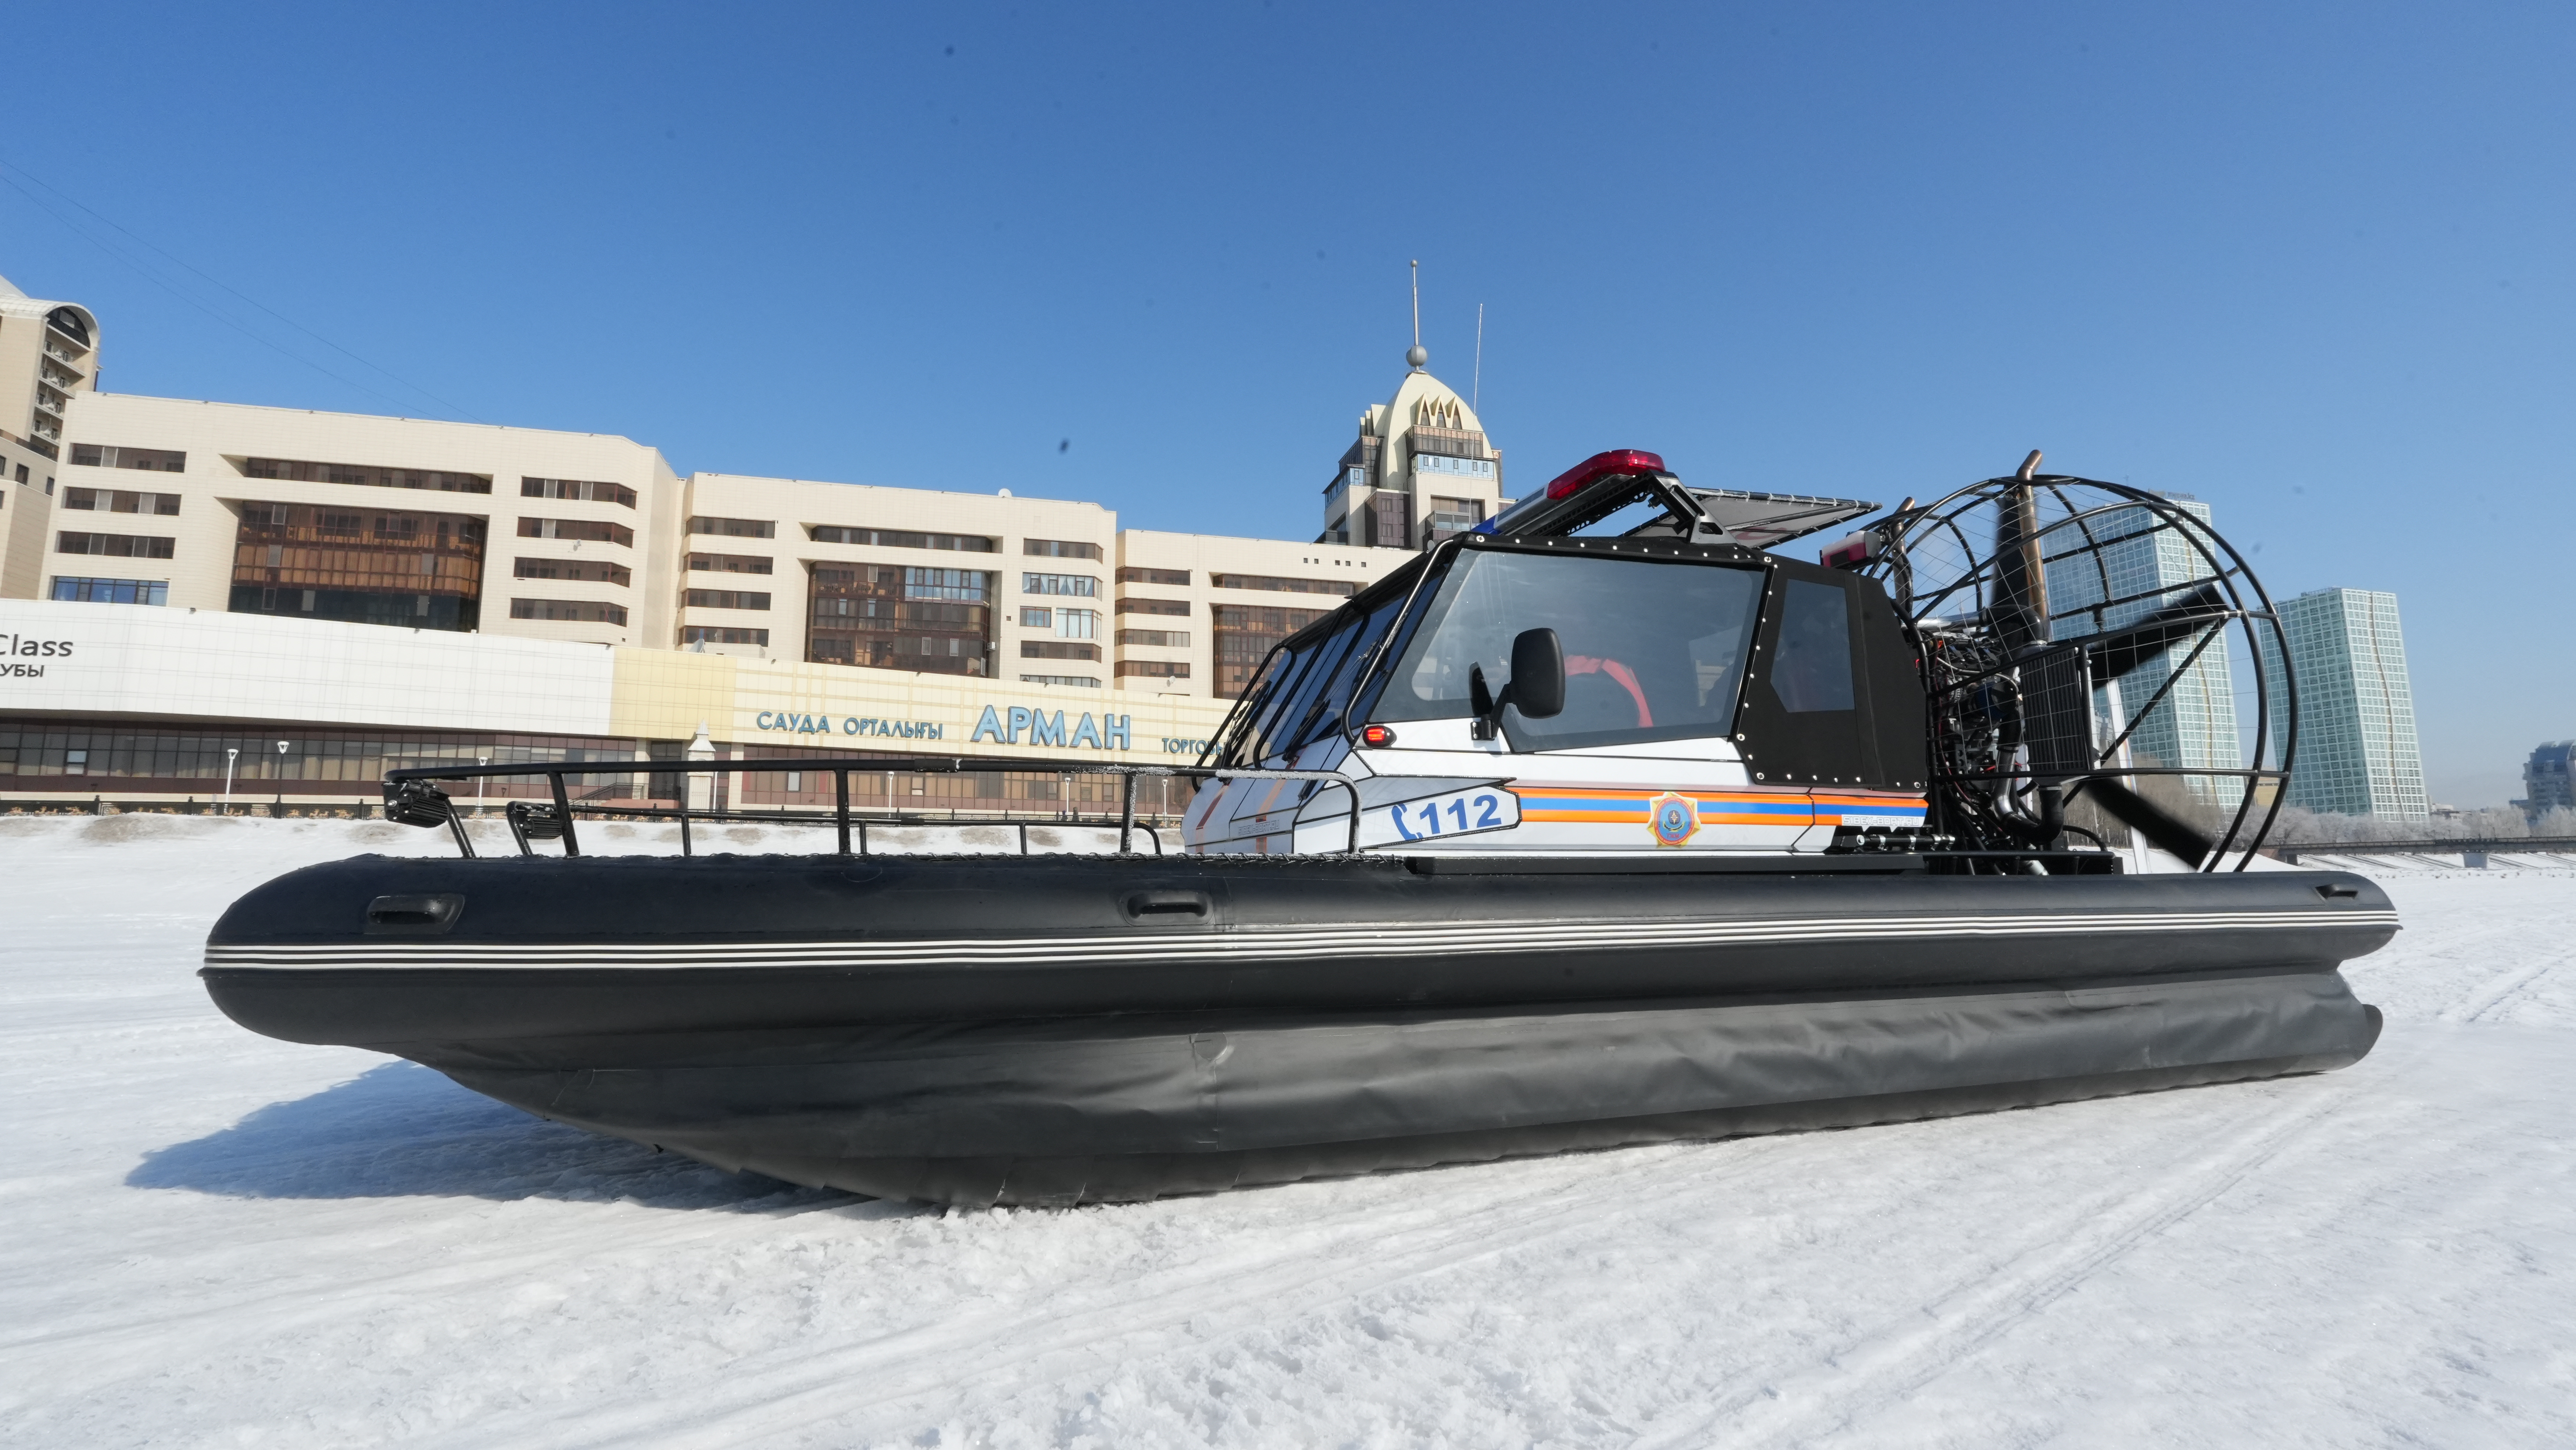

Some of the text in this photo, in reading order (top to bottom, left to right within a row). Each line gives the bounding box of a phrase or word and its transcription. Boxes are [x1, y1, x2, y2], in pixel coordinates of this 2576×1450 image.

[757, 711, 830, 735] САУДА
[843, 717, 943, 740] ОРТАЛЫҒЫ
[970, 704, 1130, 750] АРМАН
[1419, 794, 1502, 835] 112
[1843, 816, 1919, 826] SIBEX-BOAT.RU
